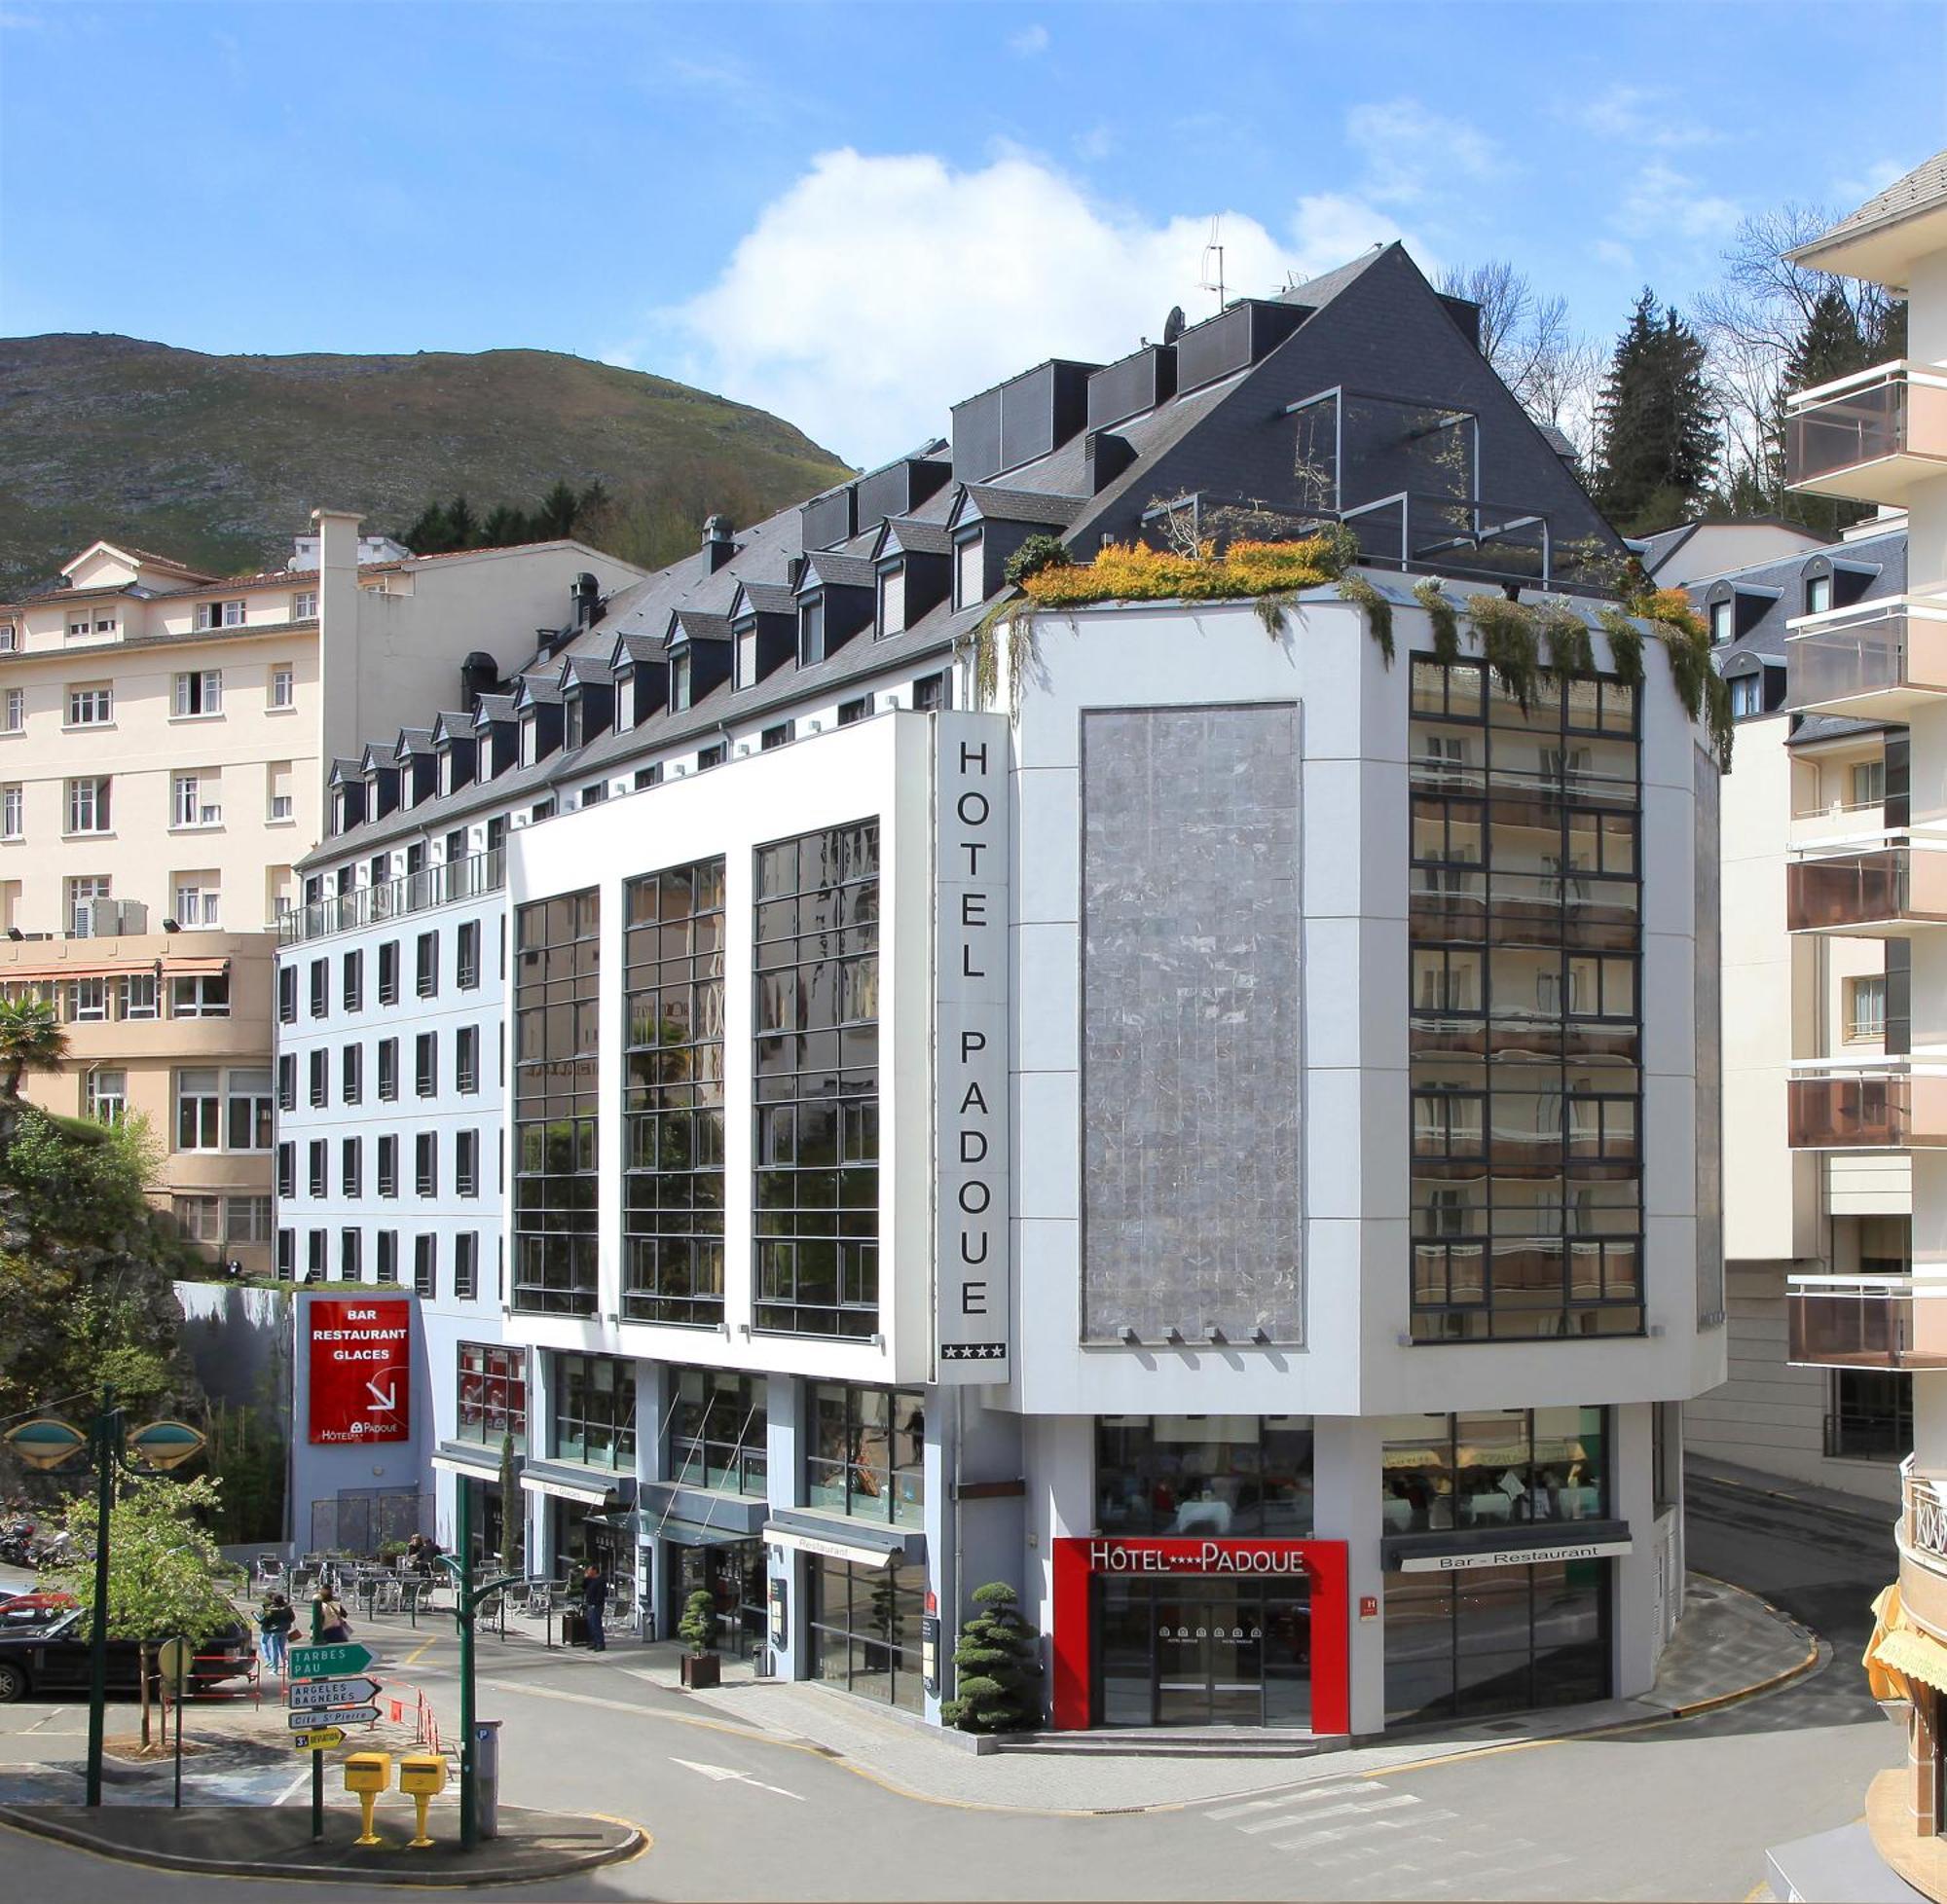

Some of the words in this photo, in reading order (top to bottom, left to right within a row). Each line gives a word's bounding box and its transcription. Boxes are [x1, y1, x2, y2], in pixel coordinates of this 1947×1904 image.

[957, 741, 990, 977] HOTEL
[958, 1031, 991, 1314] PADOUE
[347, 1310, 377, 1320] BAR
[312, 1329, 407, 1340] RESTAURANT
[333, 1349, 389, 1360] GLACES
[798, 1537, 849, 1556] Restaurant
[1090, 1541, 1170, 1571] HÔTEL
[1201, 1542, 1304, 1572] PADOUE
[1440, 1557, 1475, 1568] Bar
[1493, 1546, 1599, 1564] Restaurant
[295, 1649, 346, 1662] TARBES
[294, 1664, 320, 1674] PAU
[335, 1712, 367, 1721] Pierre
[479, 1730, 487, 1739] P
